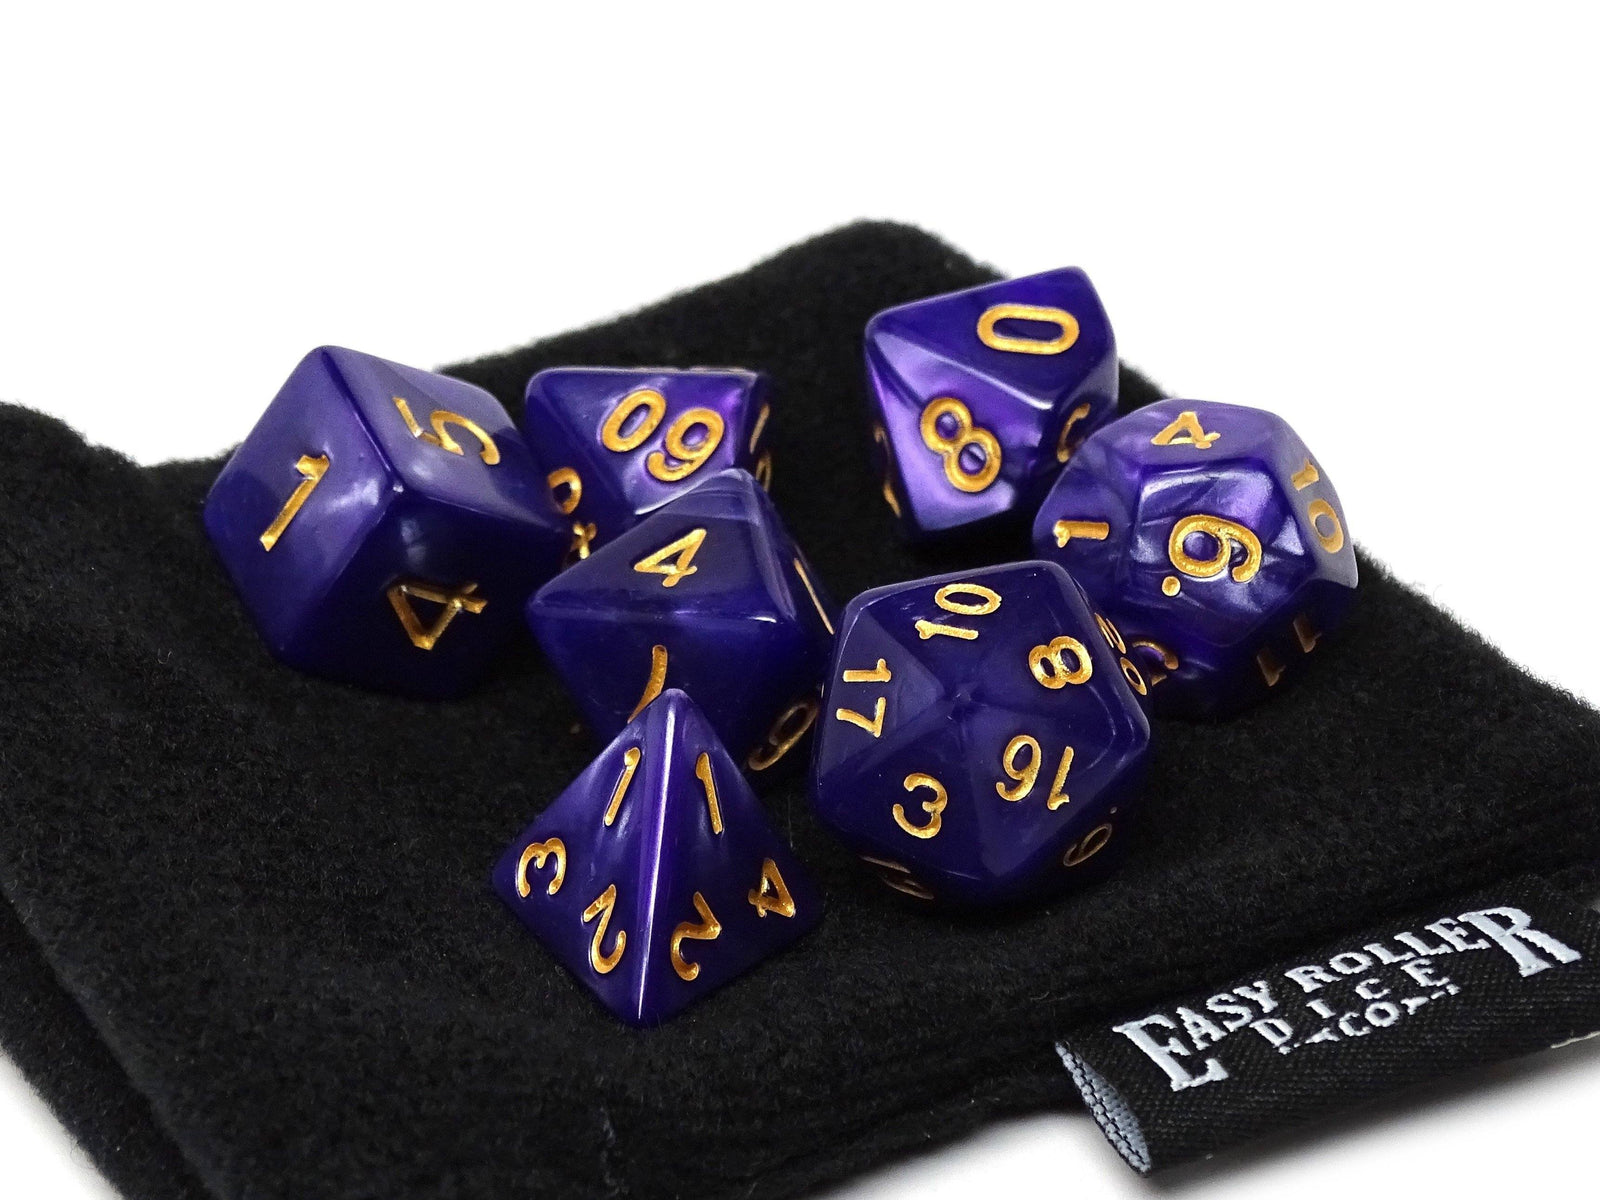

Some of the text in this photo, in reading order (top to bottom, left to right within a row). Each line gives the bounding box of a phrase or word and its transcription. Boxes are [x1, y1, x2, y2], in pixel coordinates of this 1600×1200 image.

[393, 396, 500, 465] 5
[919, 396, 1002, 494] 8
[1151, 411, 1220, 449] 4
[260, 454, 330, 552] 1
[1054, 520, 1110, 548] 1
[1290, 460, 1344, 553] 10
[634, 528, 707, 588] 4
[387, 580, 488, 651] 4
[914, 583, 1002, 640] 10
[835, 657, 892, 739] 17
[1028, 635, 1093, 690] 8
[603, 746, 641, 827] 1
[694, 752, 725, 835] 1
[891, 772, 948, 840] 3
[516, 837, 567, 898] 3
[747, 857, 796, 918] 4
[582, 884, 627, 975] 2
[669, 891, 722, 982] 2
[1111, 906, 1583, 1092] EASY ROLLER
